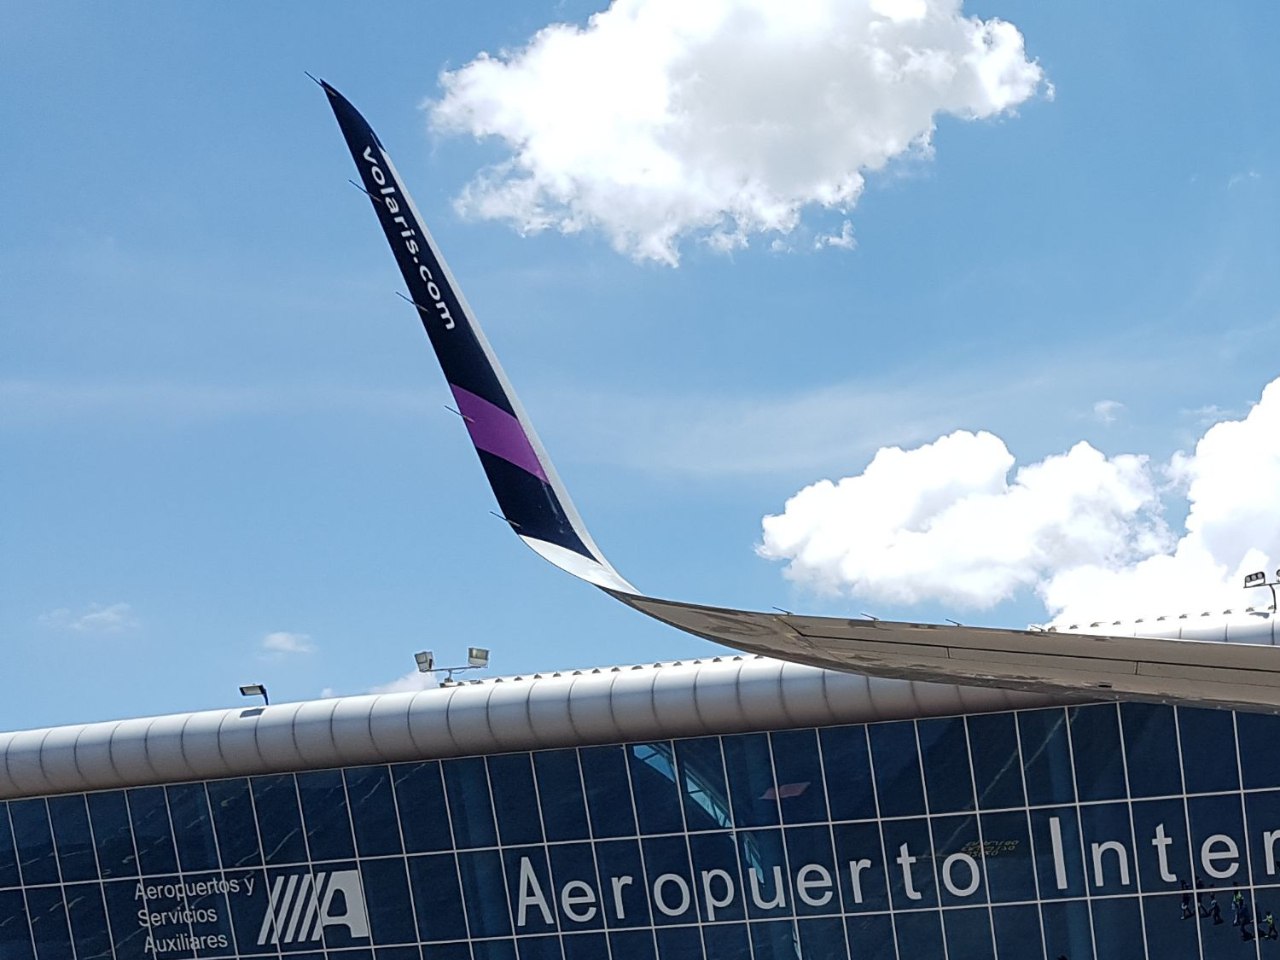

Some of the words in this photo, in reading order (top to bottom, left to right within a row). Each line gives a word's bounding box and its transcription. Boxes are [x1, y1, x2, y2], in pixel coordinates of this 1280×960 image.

[363, 145, 456, 331] volaris.com
[134, 877, 240, 901] Aeropuertos
[244, 875, 254, 896] y
[516, 842, 981, 927] Aeropuerto
[137, 905, 218, 928] Servicios
[144, 932, 229, 954] Auxiliares
